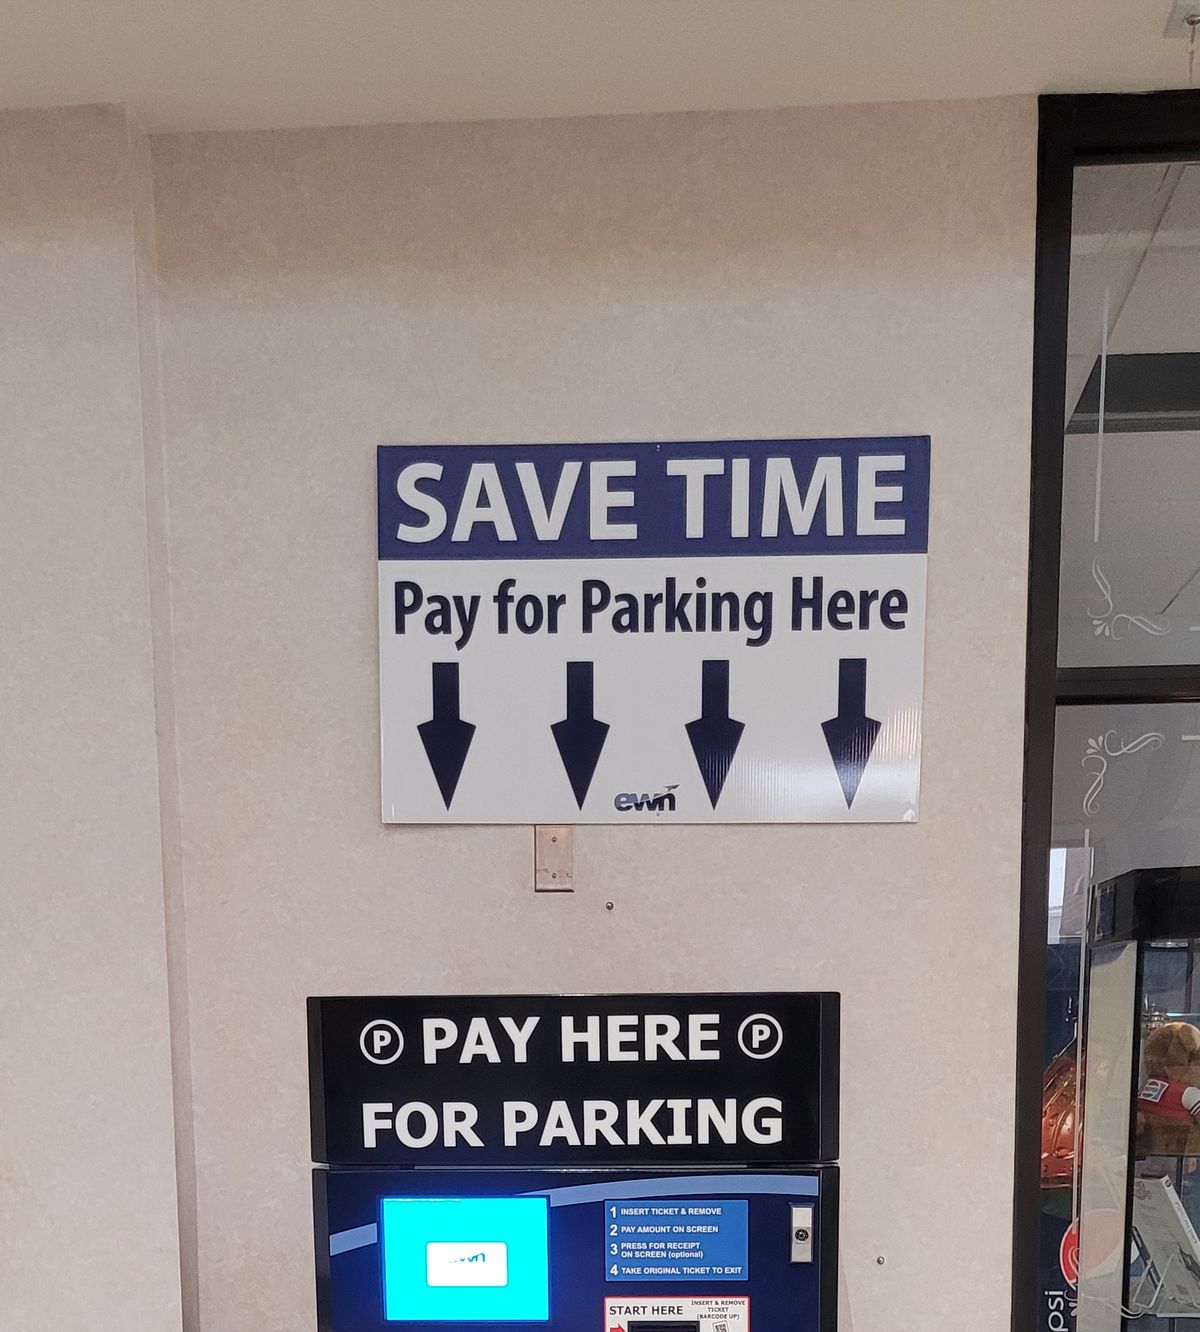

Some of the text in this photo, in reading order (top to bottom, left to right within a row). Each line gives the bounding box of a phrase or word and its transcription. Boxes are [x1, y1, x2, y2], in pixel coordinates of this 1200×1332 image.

[396, 454, 906, 544] SAVE TIME
[394, 576, 908, 651] Pay for Parking Here
[614, 786, 677, 812] ewn
[422, 1016, 541, 1064] PAY
[560, 1013, 720, 1062] HERE
[362, 1097, 784, 1149] FOR PARKING
[610, 1206, 617, 1218] 1
[621, 1208, 649, 1216] INSERT
[651, 1208, 679, 1216] TICKET
[688, 1207, 722, 1215] REMOVE
[610, 1224, 618, 1236] 2
[610, 1243, 618, 1255] 3
[668, 1250, 704, 1260] (optional)
[610, 1263, 618, 1276] 4
[622, 1267, 642, 1275] TAKE
[643, 1267, 681, 1275] ORIGINAL
[724, 1266, 743, 1274] EXIT
[609, 1305, 684, 1316] START HERE
